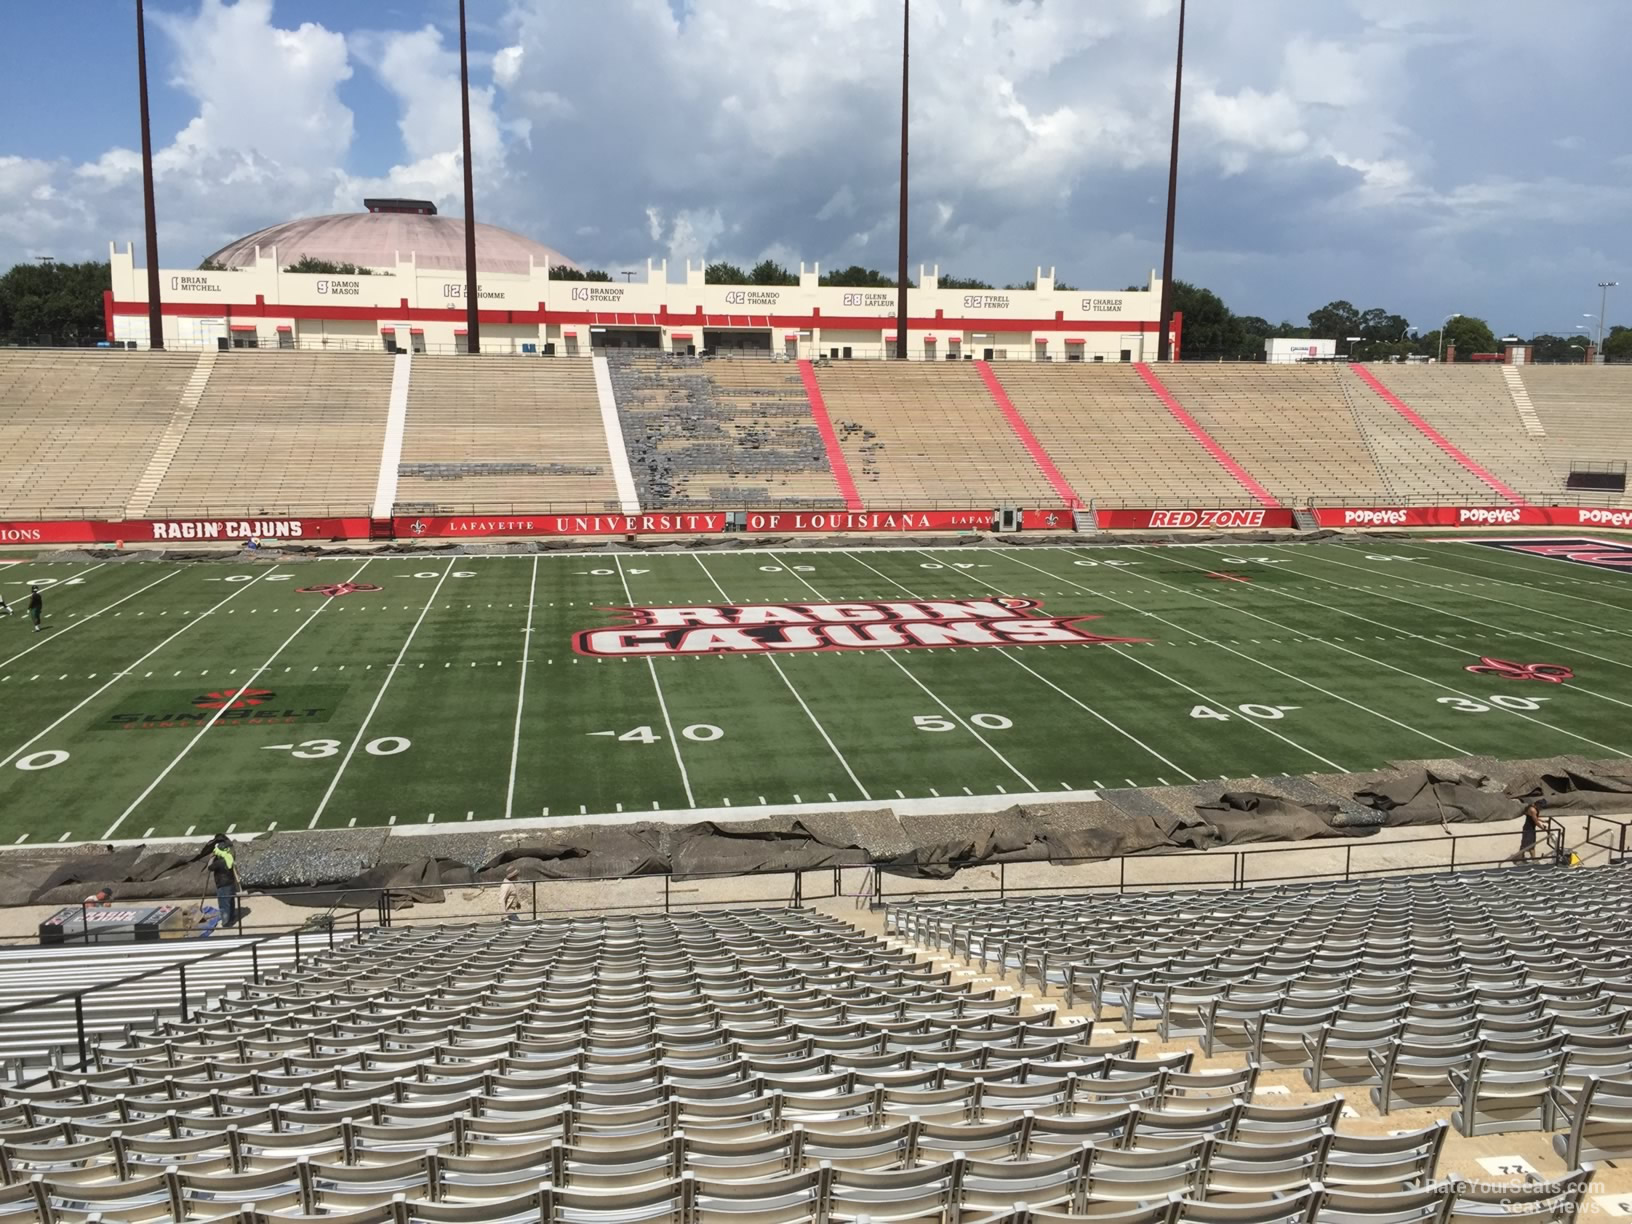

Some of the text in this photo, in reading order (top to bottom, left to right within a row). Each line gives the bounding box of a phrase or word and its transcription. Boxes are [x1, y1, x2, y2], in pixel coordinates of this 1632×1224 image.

[181, 284, 222, 292] MITCHELL
[317, 280, 329, 295] 9
[443, 284, 461, 298] 12
[572, 287, 589, 301] 14
[747, 291, 780, 299] ORLANDO
[725, 291, 746, 305] 42
[843, 293, 863, 306] 28
[963, 295, 983, 309] 32
[984, 295, 1010, 303] TYRELL
[1081, 299, 1092, 312] 5
[449, 521, 534, 531] LAFAYETTE
[556, 515, 718, 532] UNIVERSITY
[751, 514, 780, 529] OF
[794, 513, 931, 530] LOUISIANA
[1148, 509, 1266, 528] RED ZONE
[1344, 508, 1408, 525] POPEYES
[1459, 508, 1521, 524] POPEYES
[224, 520, 303, 538] CAJUNS
[590, 618, 1095, 655] CAJUNS
[1436, 695, 1541, 712] 30
[106, 709, 326, 724] SUN BELT
[1189, 703, 1284, 721] 40
[912, 713, 1014, 732] 50
[617, 724, 725, 745] 40
[291, 738, 412, 759] 30
